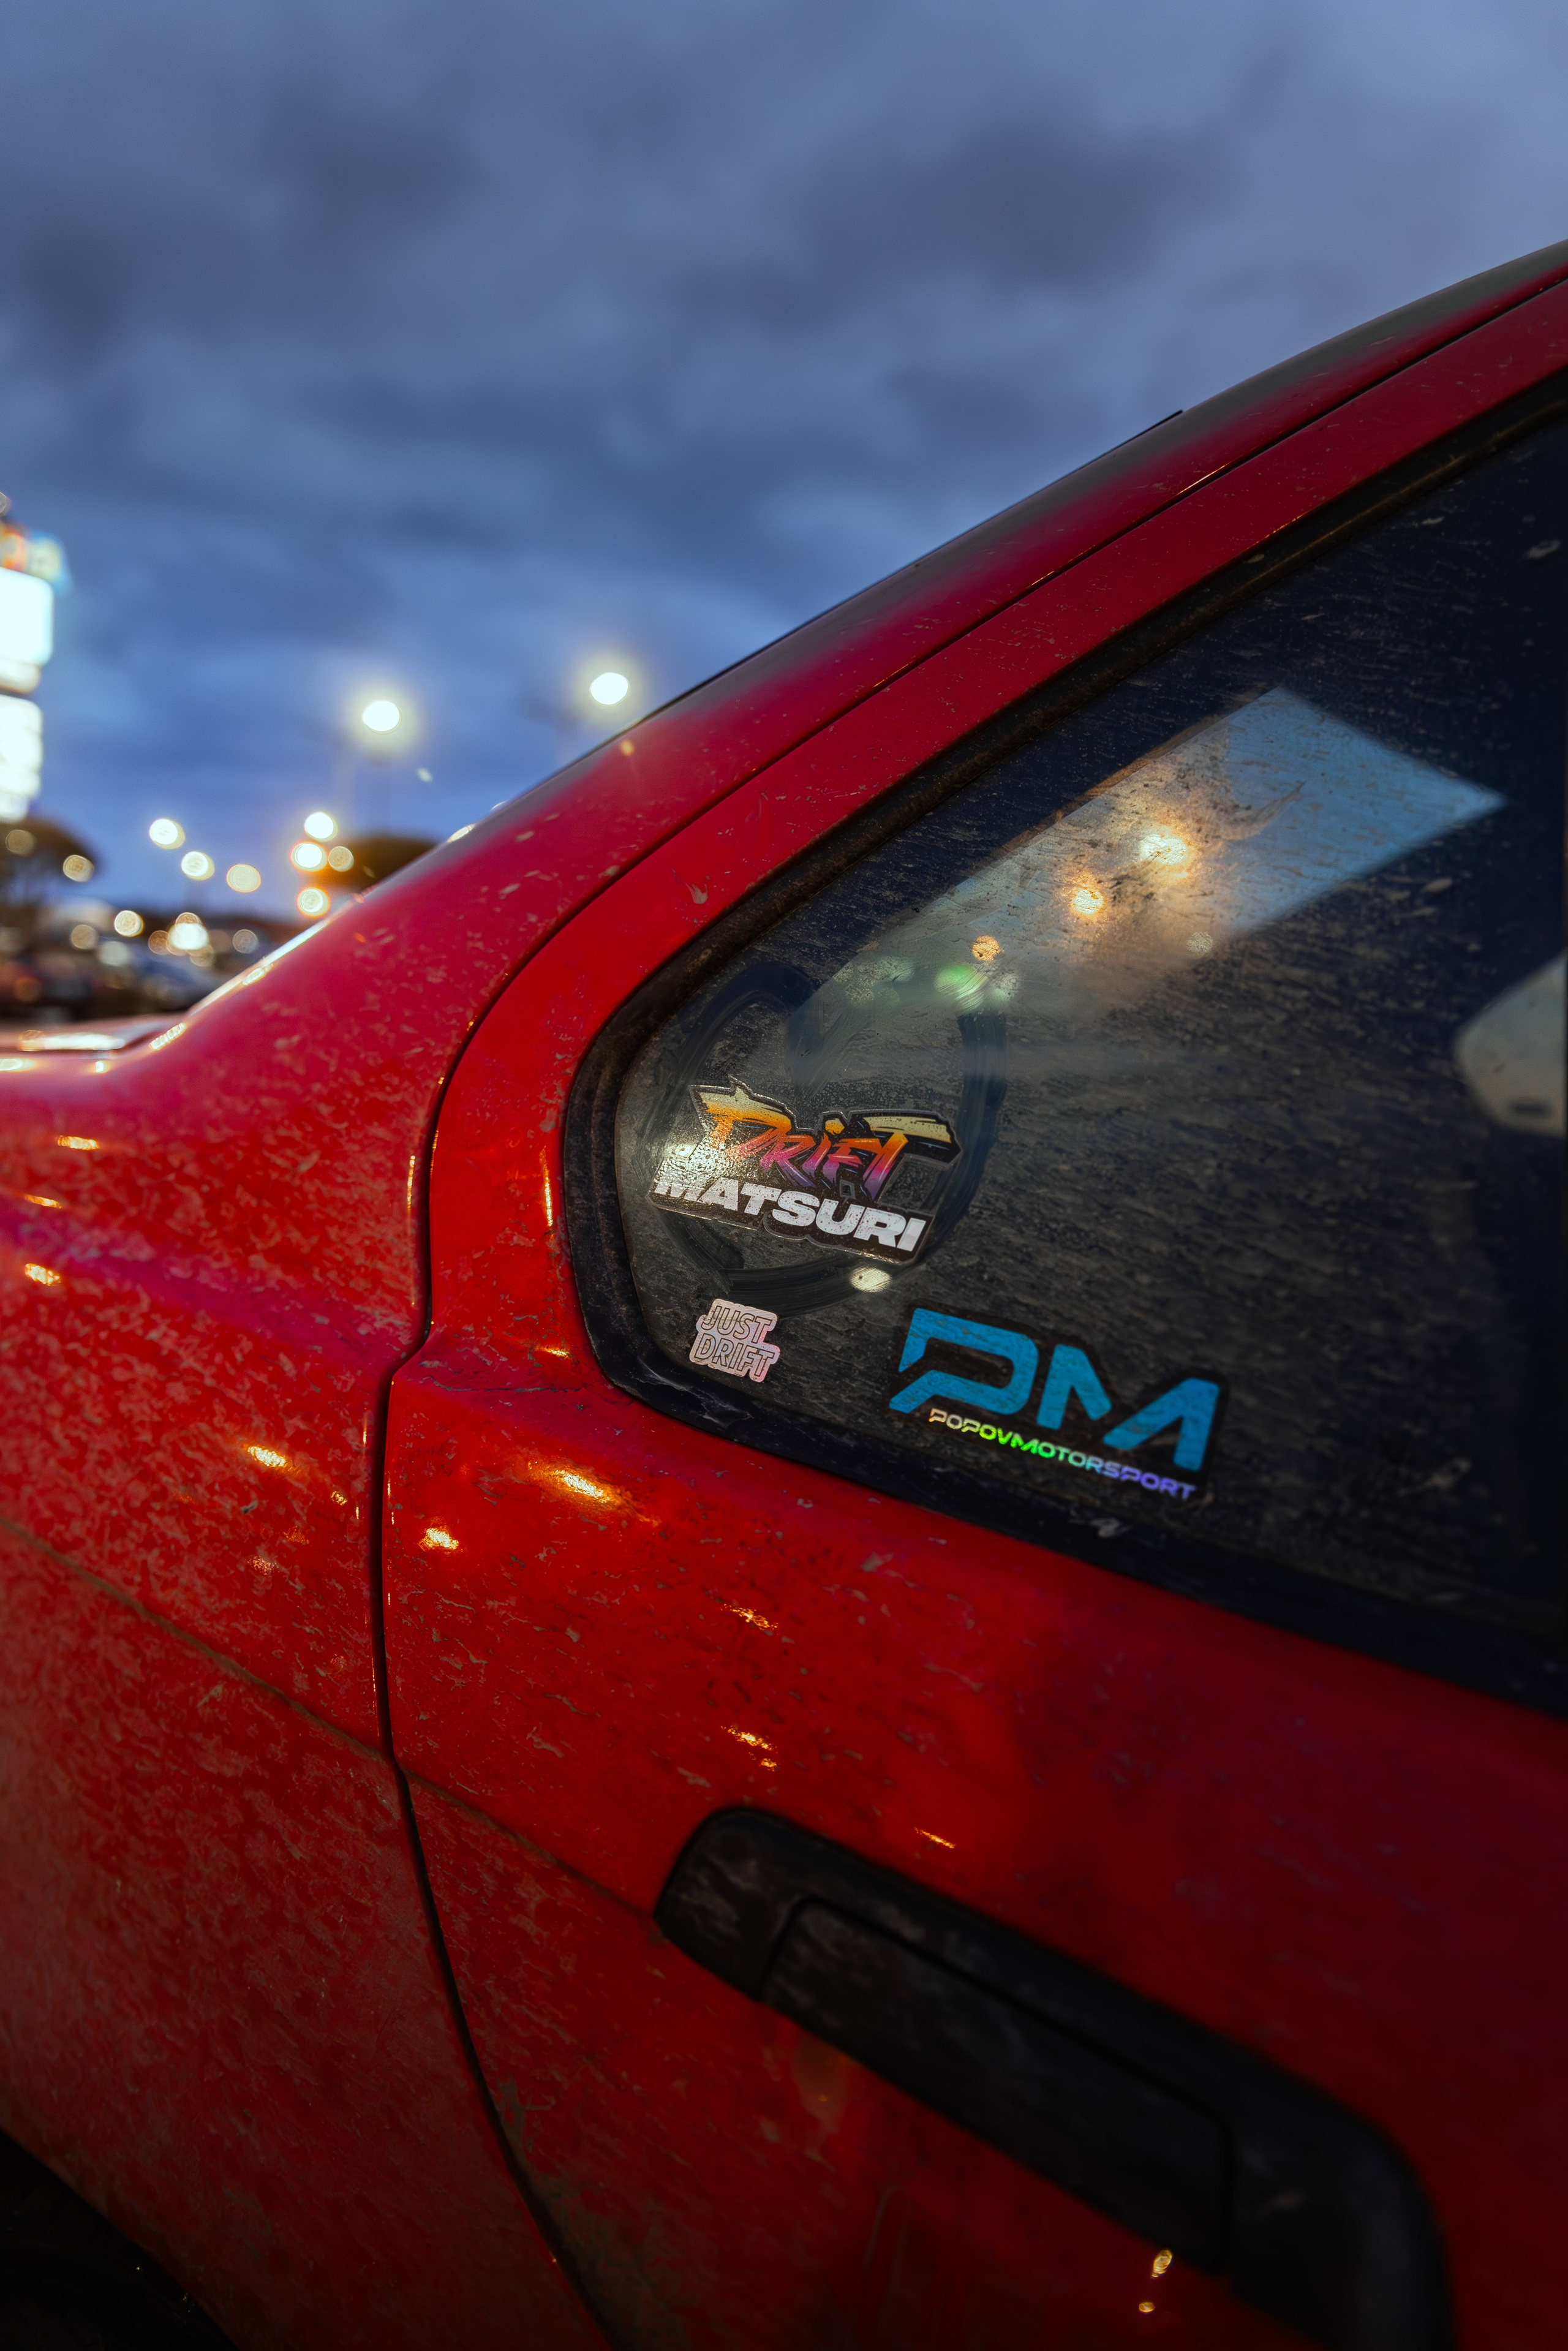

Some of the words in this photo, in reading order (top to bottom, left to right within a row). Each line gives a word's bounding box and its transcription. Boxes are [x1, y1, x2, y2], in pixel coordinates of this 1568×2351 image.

[654, 1164, 927, 1253] MATSURI
[693, 1332, 776, 1377] DRIFT
[700, 1305, 773, 1345] JUST
[929, 1408, 1197, 1501] POPOVMOTORSPORT
